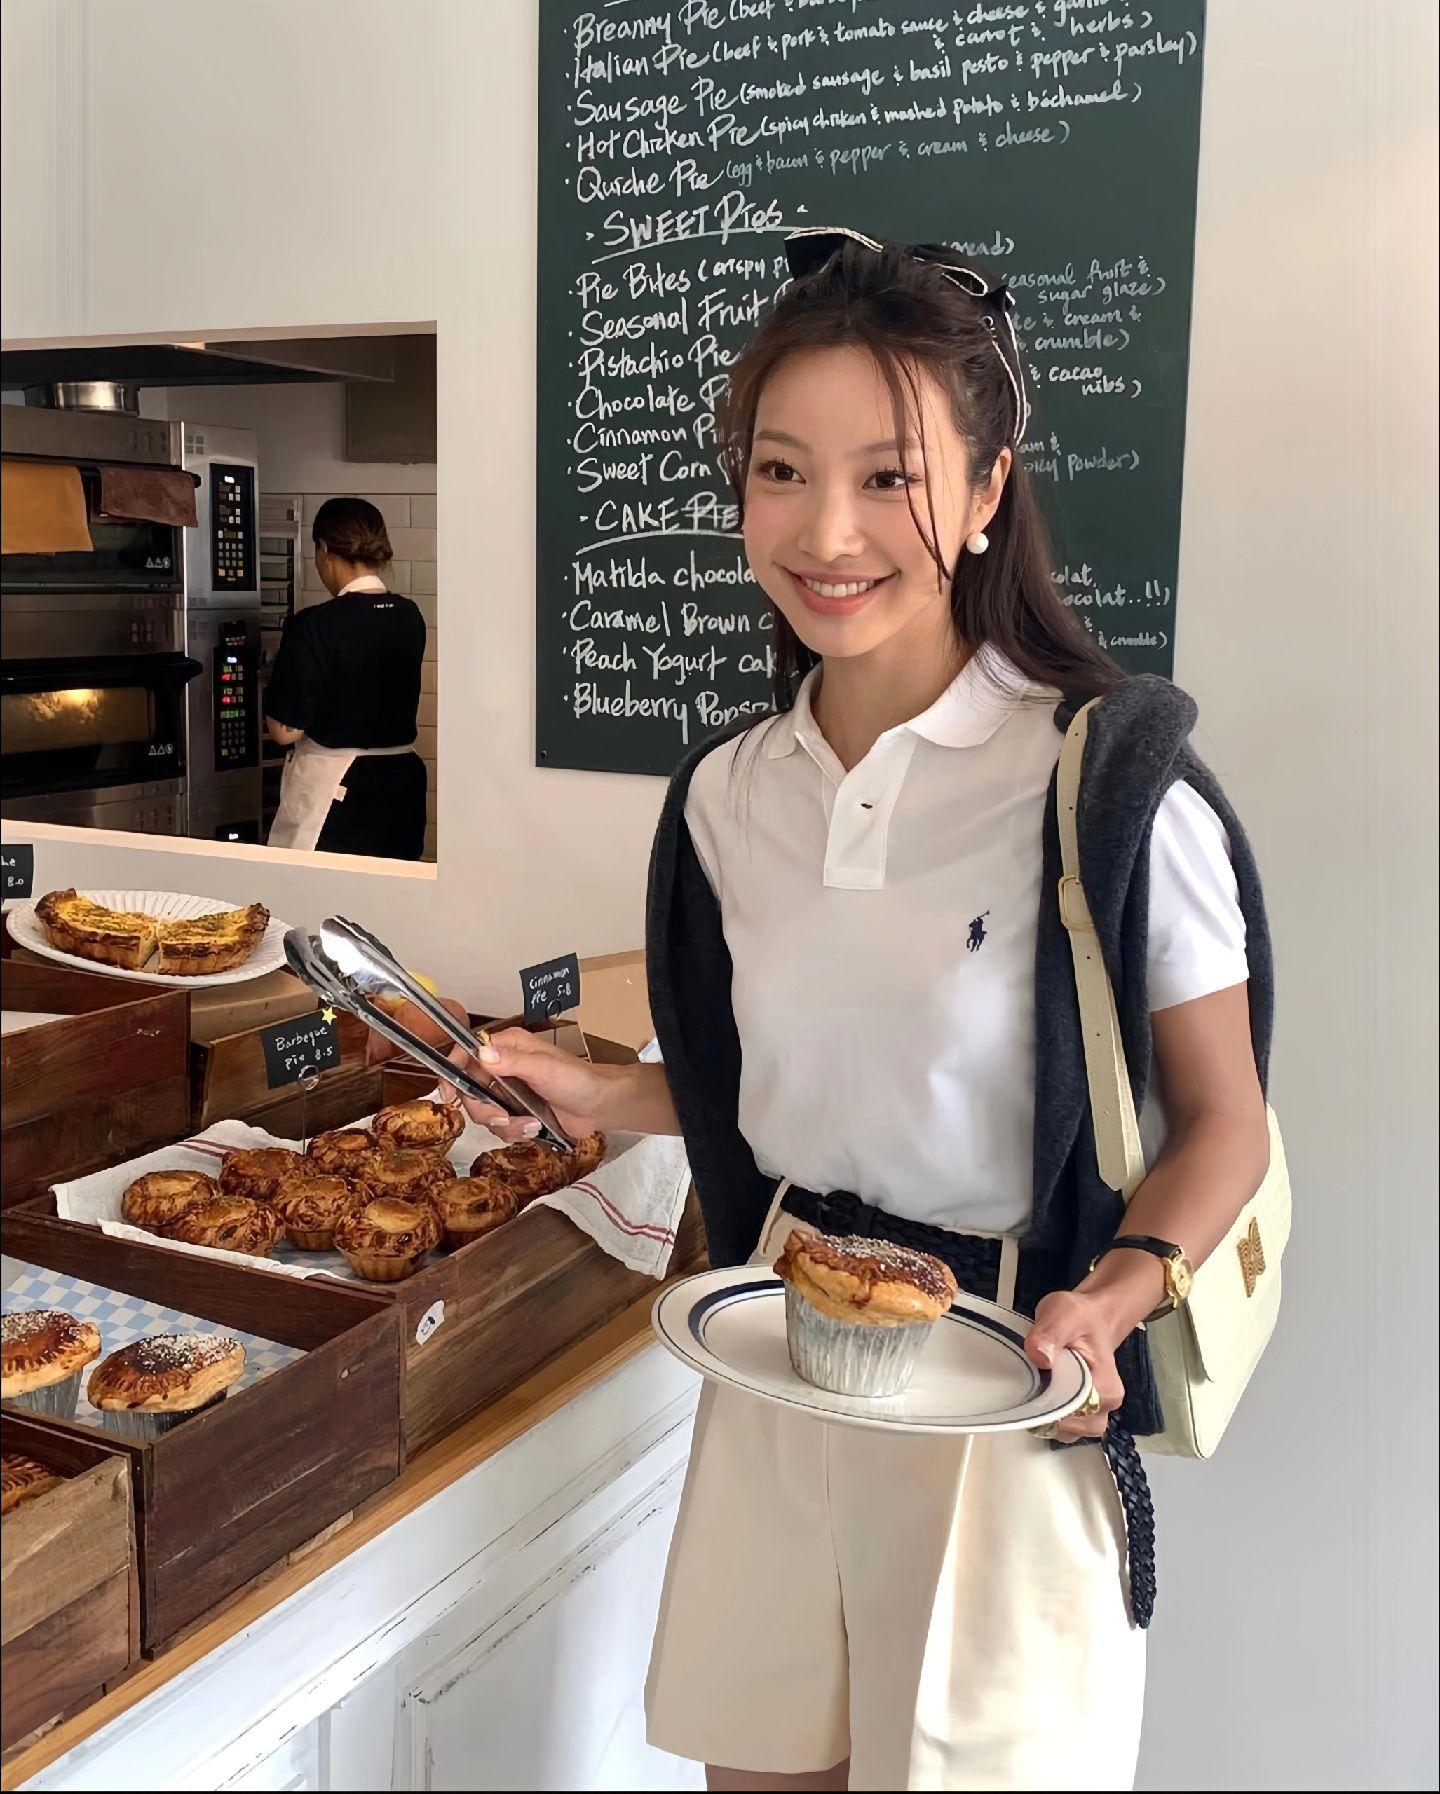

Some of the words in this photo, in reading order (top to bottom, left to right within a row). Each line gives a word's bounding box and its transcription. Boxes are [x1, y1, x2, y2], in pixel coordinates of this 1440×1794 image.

[573, 13, 671, 55] Breanny
[678, 0, 727, 35] Pie
[574, 51, 650, 88] Italian
[652, 43, 709, 75] Pie
[713, 36, 761, 62] (beef
[834, 17, 895, 42] tomato
[901, 17, 948, 34] sauce
[967, 3, 1029, 24] cheese
[574, 90, 687, 130] Sausage
[690, 76, 741, 116] Pie
[812, 69, 885, 96] sausage
[909, 56, 951, 81] basil
[961, 58, 1008, 85] pesto
[1030, 47, 1096, 78] pepper
[578, 130, 620, 162] Hot
[623, 130, 705, 159] Chicken
[707, 114, 760, 151] Pie
[884, 96, 947, 123] mashed
[952, 93, 1004, 124] potato
[576, 166, 665, 203] Quiche
[668, 159, 725, 197] Pie
[830, 143, 892, 175] pepper
[917, 140, 968, 156] cream
[603, 205, 709, 249] SWEET
[575, 271, 619, 309] Pie
[622, 262, 691, 299] Bites
[772, 255, 789, 279] pi
[1001, 262, 1076, 289] easonal
[1037, 284, 1093, 315] sugar
[579, 298, 689, 346] Seasonal
[697, 288, 769, 331] Fruit
[1064, 309, 1123, 325] cream
[578, 341, 685, 389] Pistachio
[687, 333, 741, 379] Pie
[1048, 366, 1103, 382] cacao
[575, 384, 696, 421] Chocolate
[699, 373, 733, 413] Pi
[573, 422, 688, 454] Cinnamon
[692, 412, 718, 450] Pi
[577, 452, 654, 493] Sweet
[659, 450, 713, 482] Corn
[595, 497, 680, 533] CAKE
[681, 491, 739, 533] PIE
[572, 556, 666, 596] Matilda
[673, 550, 756, 592] chocola
[569, 600, 671, 637] Caramel
[681, 602, 750, 637] Brown
[571, 637, 637, 675] Peach
[642, 642, 728, 686] Yogurt
[738, 644, 778, 679] cak
[573, 680, 689, 745] Blueberry
